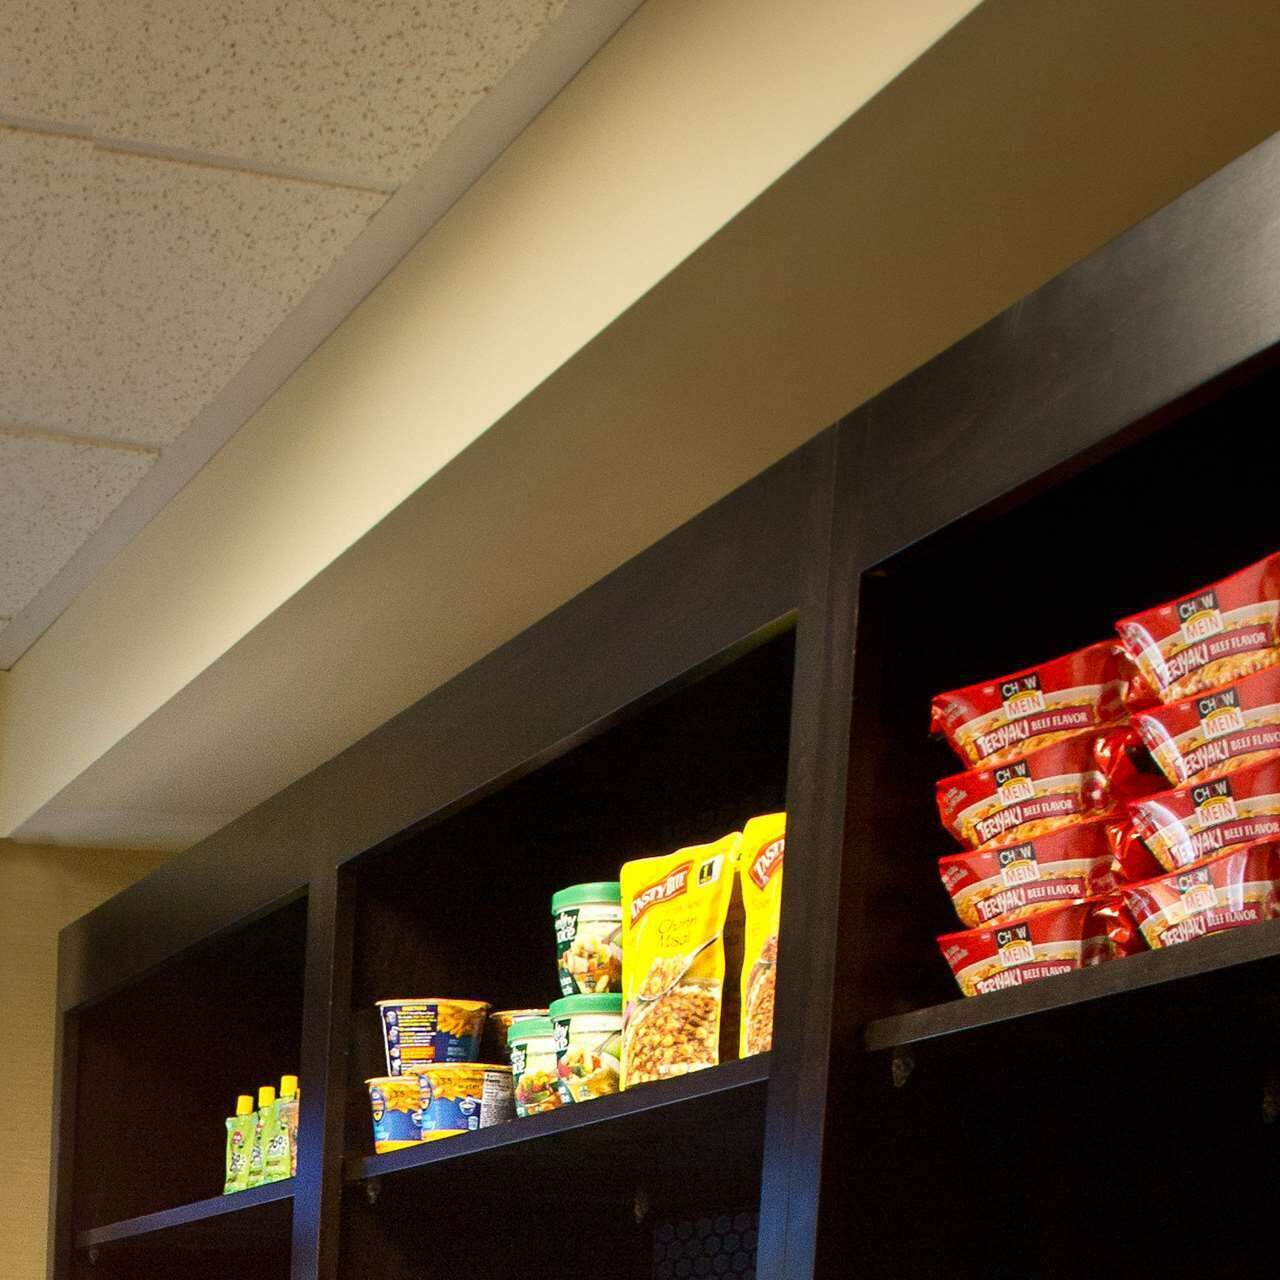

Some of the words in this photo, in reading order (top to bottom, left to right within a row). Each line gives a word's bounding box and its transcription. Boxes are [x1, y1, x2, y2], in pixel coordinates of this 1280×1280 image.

[1179, 593, 1214, 618] CHW
[1186, 617, 1221, 639] MEIN
[1162, 643, 1209, 686] ERIYAKI
[1230, 632, 1267, 648] FLAVOR
[1002, 676, 1038, 697] CHW
[1008, 697, 1042, 716] MEIN
[1199, 690, 1235, 714] CHW
[976, 719, 1029, 757] TERIYAKI
[1031, 717, 1051, 731] BEEF
[1052, 712, 1089, 727] FLAVOR
[1206, 715, 1239, 736] MEIN
[995, 763, 1026, 784] CHW
[1001, 784, 1032, 802] MEIN
[1193, 781, 1227, 803] CHW
[975, 807, 1022, 841] TERIYAKI
[1023, 804, 1042, 817] BEEF
[1042, 799, 1073, 813] FLAVOR
[1200, 802, 1233, 823] MEIN
[1170, 828, 1223, 867] TEIYAKI
[1244, 821, 1280, 836] FLAVOR
[999, 845, 1032, 865] CHW
[1005, 866, 1037, 884] MEIN
[1178, 868, 1209, 891] CHW
[631, 883, 666, 921] TASTY
[976, 887, 1026, 921] TERIYAKI
[1026, 886, 1047, 898] BEEF
[1047, 883, 1081, 897] FLAVOR
[1224, 909, 1258, 923] FLAVOR
[997, 926, 1027, 944] CHW
[1003, 947, 1031, 964] MEIN
[1022, 968, 1041, 980] BEEF
